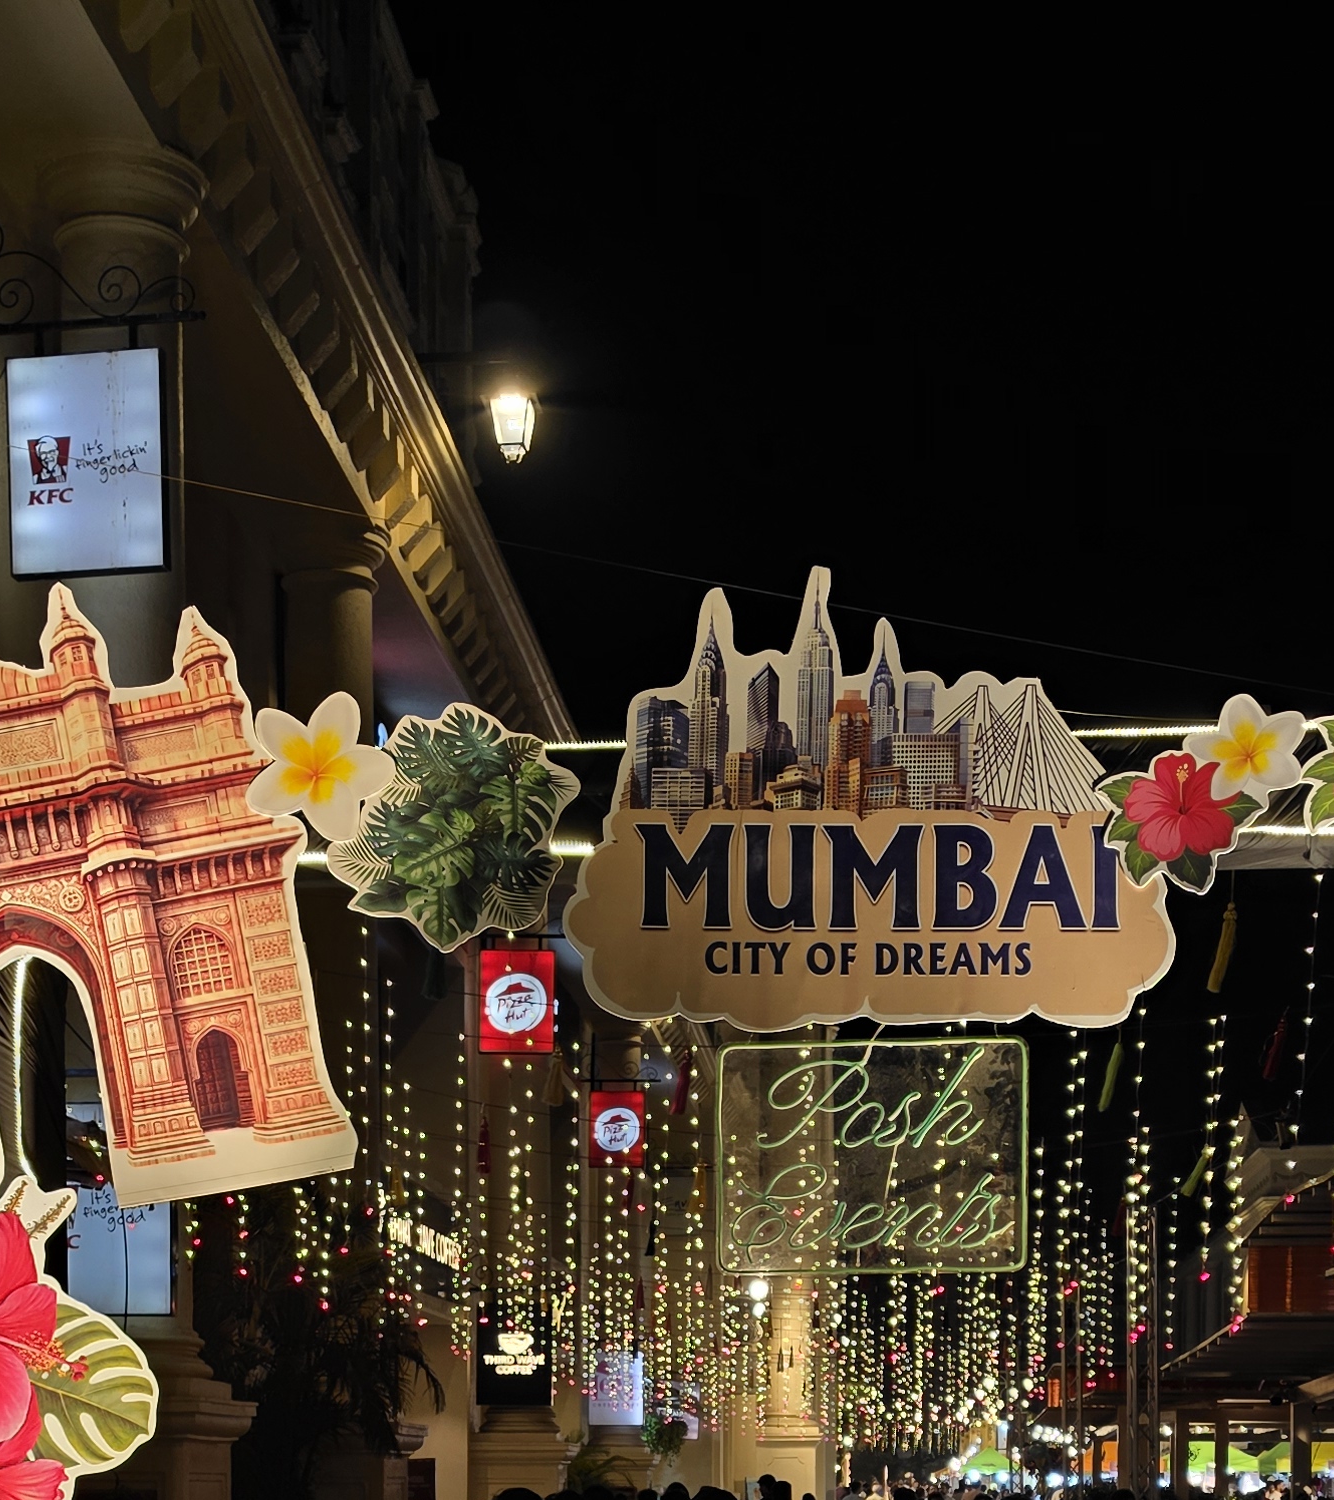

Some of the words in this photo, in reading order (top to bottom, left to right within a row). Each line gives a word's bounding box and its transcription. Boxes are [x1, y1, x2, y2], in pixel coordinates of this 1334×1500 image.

[82, 439, 103, 456] It's
[100, 458, 139, 483] good
[27, 488, 74, 506] KFC
[633, 822, 1121, 931] MUMBAI
[704, 941, 791, 977] CITY
[805, 942, 858, 977] OF
[874, 941, 1034, 978] DREAMS
[497, 994, 534, 1013] Pizza
[505, 1008, 529, 1024] Hut
[756, 1043, 985, 1149] Posh
[608, 1133, 628, 1146] Hut
[90, 1189, 112, 1205] It's
[83, 1205, 120, 1219] finger
[107, 1210, 146, 1232] good
[731, 1163, 1016, 1264] Events
[483, 1355, 515, 1365] THIRD
